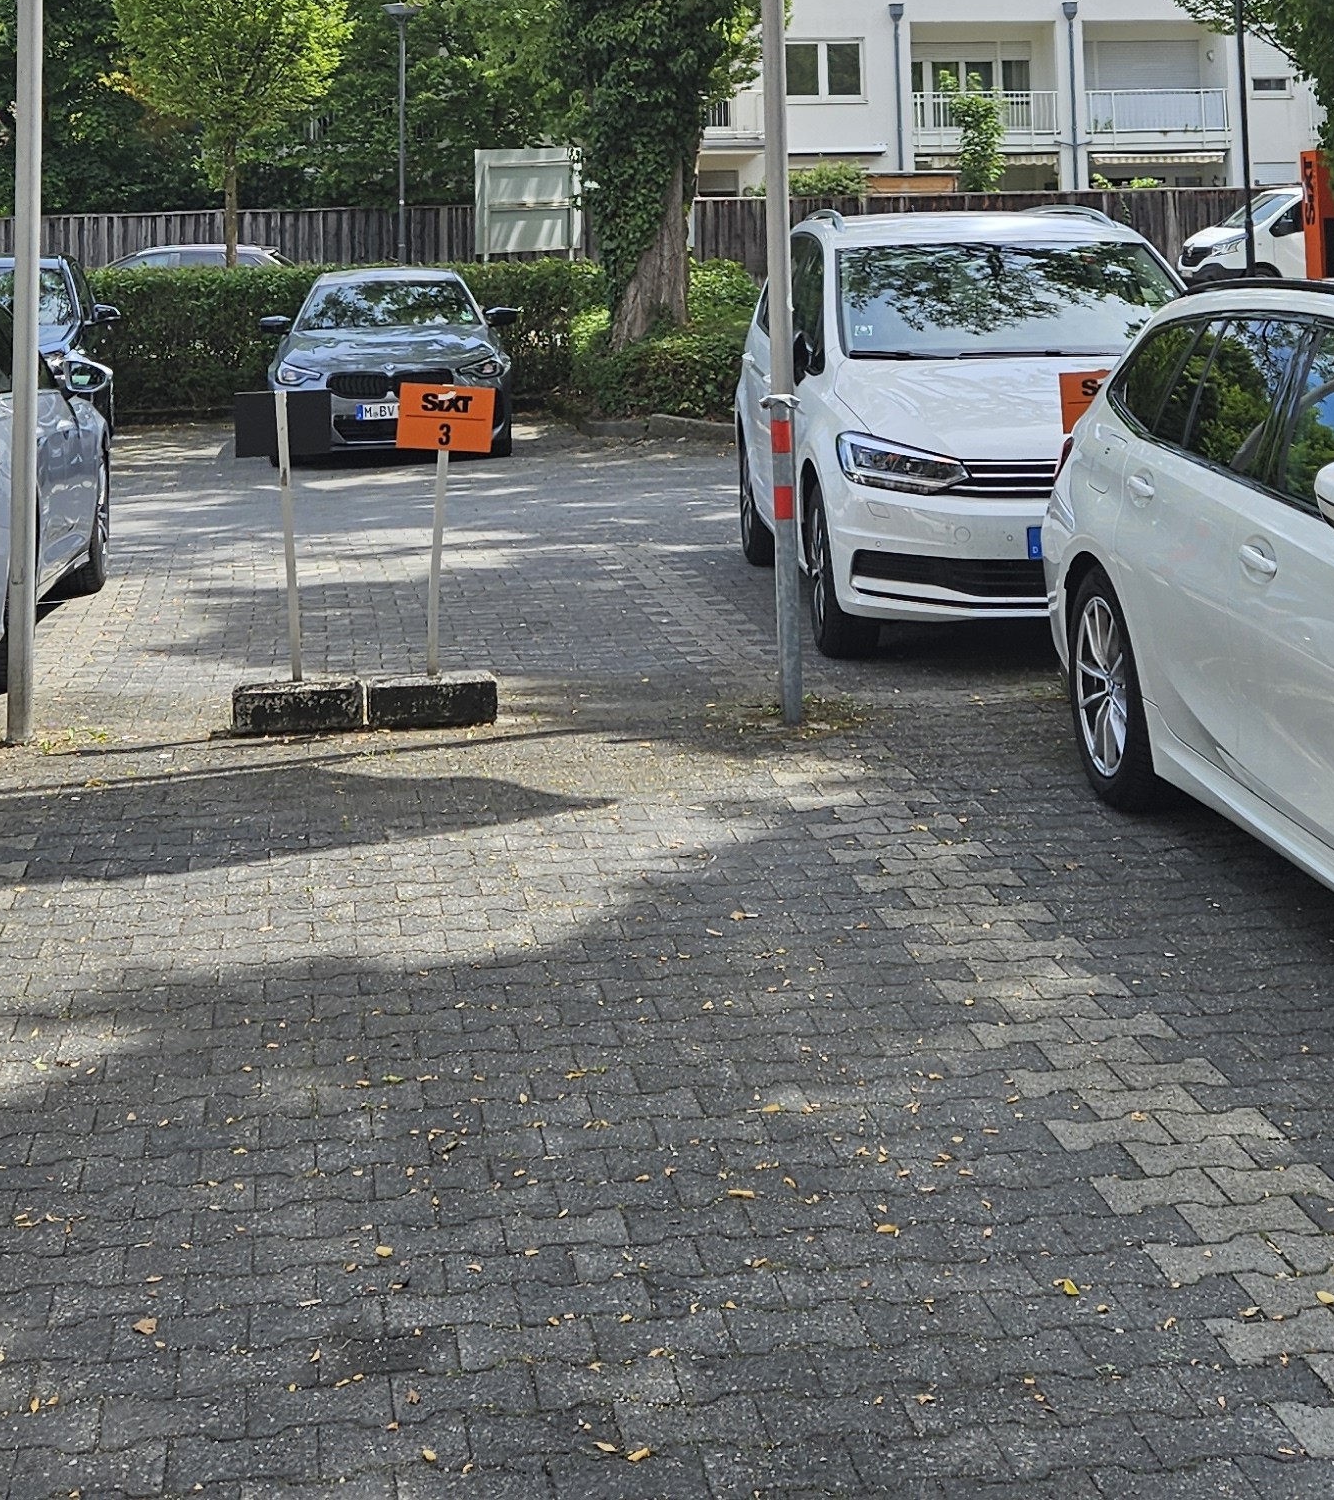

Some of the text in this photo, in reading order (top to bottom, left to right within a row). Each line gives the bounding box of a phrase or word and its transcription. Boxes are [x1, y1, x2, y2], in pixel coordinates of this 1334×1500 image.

[364, 406, 372, 418] M
[379, 405, 395, 417] BV
[438, 423, 451, 445] 3
